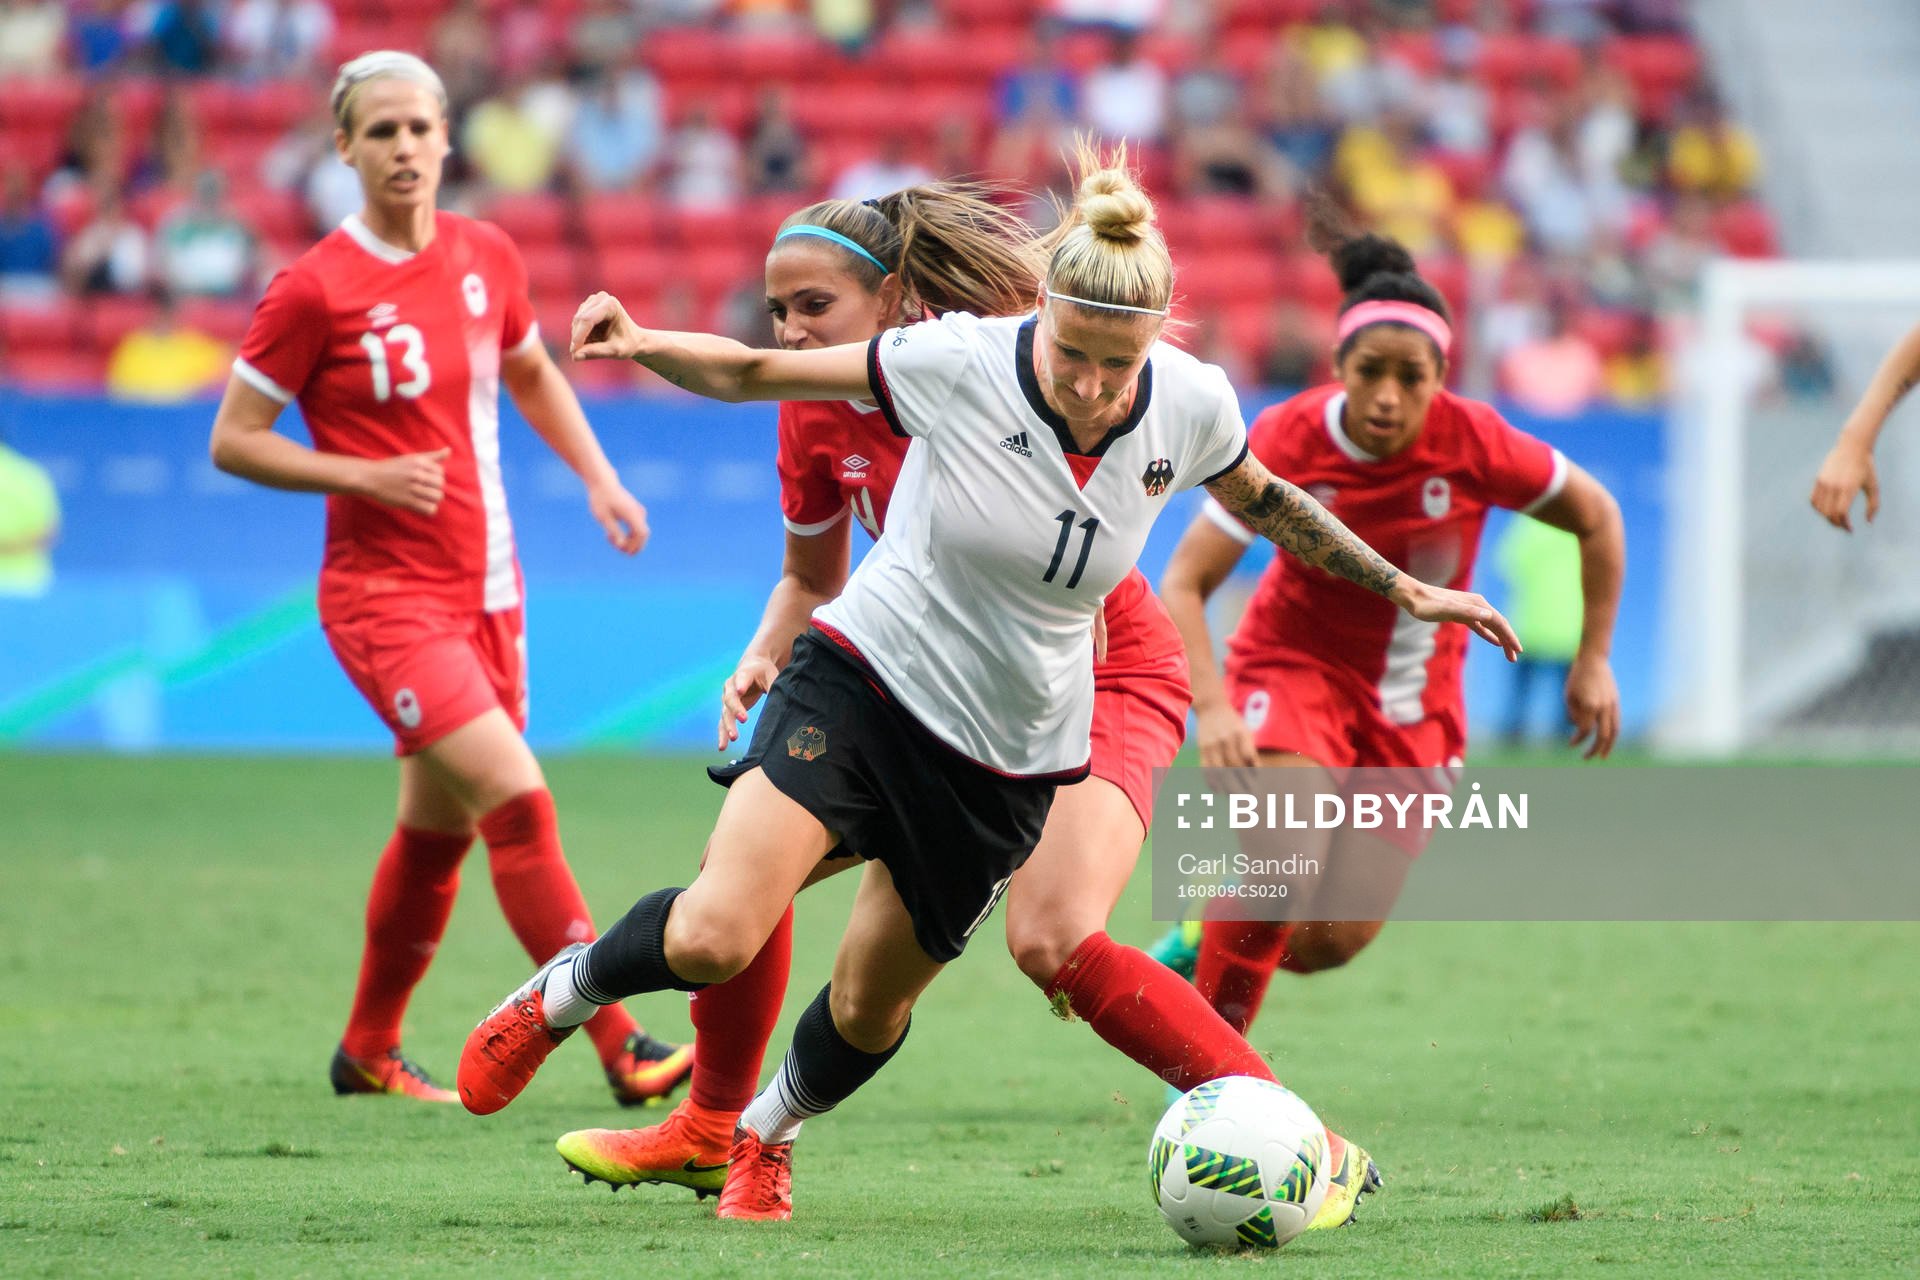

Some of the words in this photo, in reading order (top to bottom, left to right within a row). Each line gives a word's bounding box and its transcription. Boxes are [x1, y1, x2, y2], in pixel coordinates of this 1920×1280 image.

[360, 323, 431, 402] 13
[1000, 440, 1033, 458] adidas
[842, 470, 867, 479] umbro
[1042, 509, 1100, 590] 11
